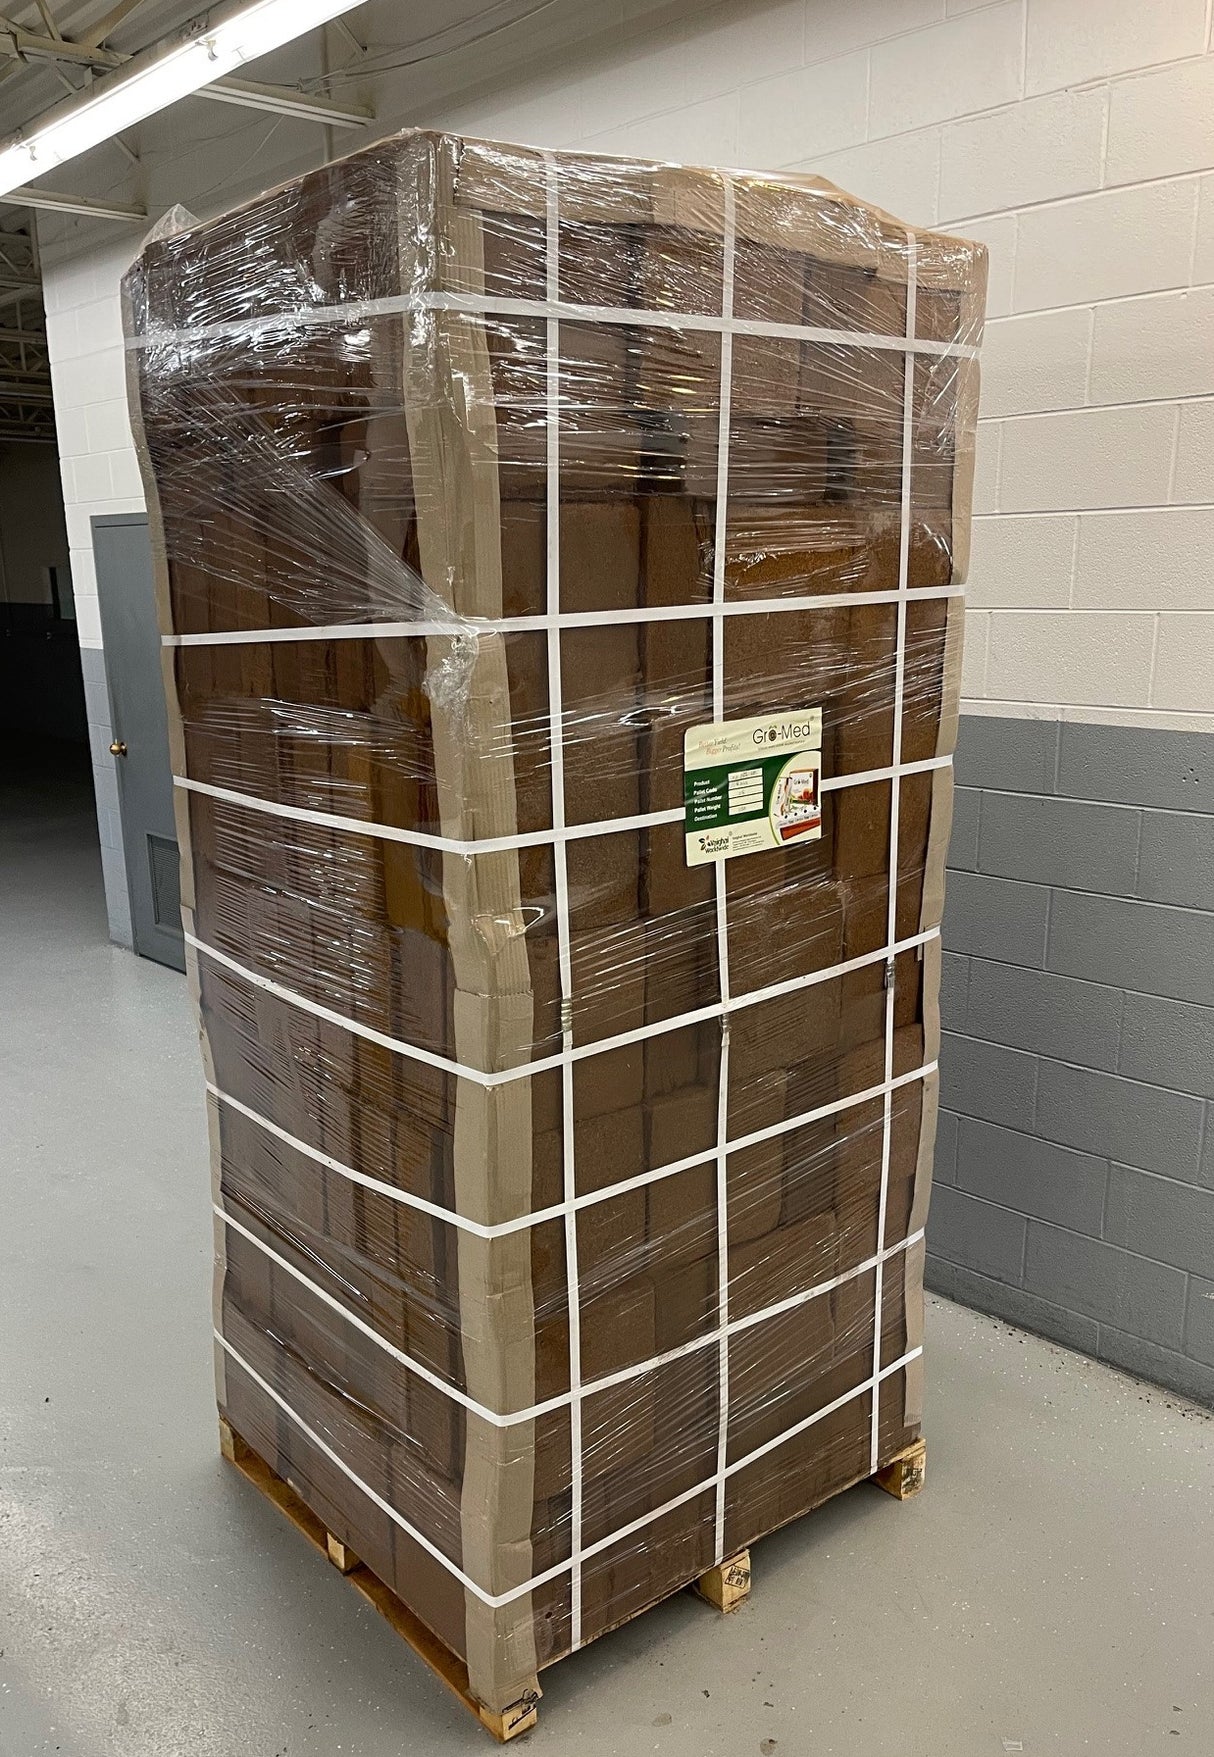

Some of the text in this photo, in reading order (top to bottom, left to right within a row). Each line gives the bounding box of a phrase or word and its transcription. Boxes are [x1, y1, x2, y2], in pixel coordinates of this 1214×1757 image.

[693, 779, 710, 787] Product
[706, 794, 723, 802] Number
[706, 803, 722, 811] Weight
[693, 813, 718, 822] Destination
[704, 844, 729, 854] Worldwide
